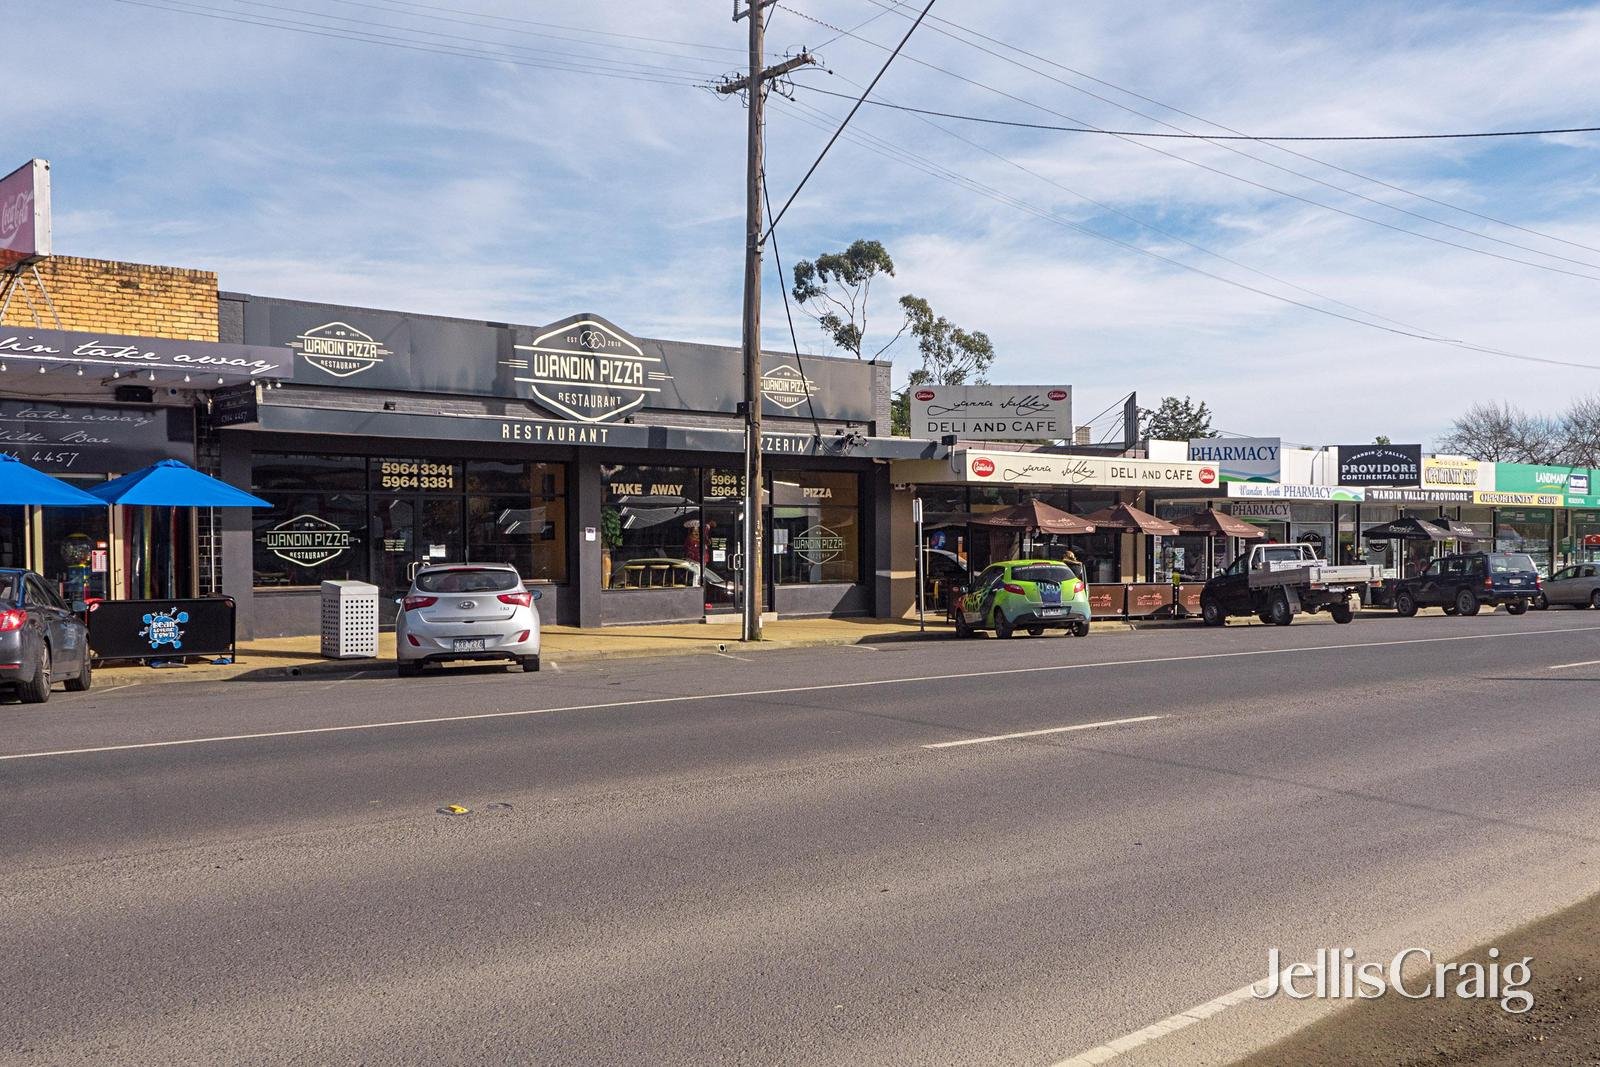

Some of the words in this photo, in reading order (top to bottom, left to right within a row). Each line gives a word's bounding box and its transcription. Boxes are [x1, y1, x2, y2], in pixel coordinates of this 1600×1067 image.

[304, 339, 345, 355] WANDIN
[346, 343, 377, 358] PIZZA
[72, 341, 161, 361] take
[173, 353, 279, 375] away
[320, 360, 361, 370] RESTAURANT
[533, 353, 595, 381] WANDIN
[599, 359, 643, 385] PIZZA
[763, 379, 789, 392] WANDIN
[558, 392, 622, 408] RESTAURANT
[16, 407, 74, 420] take
[82, 414, 154, 427] away
[502, 423, 609, 443] RESTAURANT
[928, 421, 966, 433] DELI
[972, 422, 1007, 433] AND
[1012, 421, 1057, 432] CAFE
[59, 430, 112, 444] Bar
[31, 451, 80, 467] 4457
[1191, 446, 1279, 461] PHARMACY
[1351, 451, 1375, 460] WANDIN
[1384, 450, 1408, 460] VALLEY
[381, 462, 419, 474] 5964
[420, 464, 453, 476] 3341
[1111, 467, 1137, 478] DELI
[1142, 470, 1161, 480] AND
[1165, 469, 1193, 481] CAFE
[1341, 464, 1417, 473] PROVIDORE
[382, 476, 419, 488] 5964
[420, 477, 453, 489] 3381
[711, 475, 737, 485] 5964
[610, 483, 642, 495] TAKE
[650, 484, 684, 496] AWAY
[711, 486, 738, 496] 5964
[803, 488, 832, 498] PIZZA
[1283, 485, 1332, 499] PHARMACY
[1372, 490, 1402, 501] WANDIN
[1404, 490, 1429, 501] VALLEY
[1431, 491, 1468, 501] PROVIDORE
[1479, 492, 1534, 504] OPPORTUNITY
[1537, 495, 1559, 505] SHOP
[1232, 504, 1289, 516] PHARMACY
[267, 534, 312, 546] WANDIN
[314, 533, 349, 546] PIZZA
[793, 539, 821, 549] WANDIN
[822, 539, 843, 549] PIZZA
[289, 551, 328, 560] RESTAURANT
